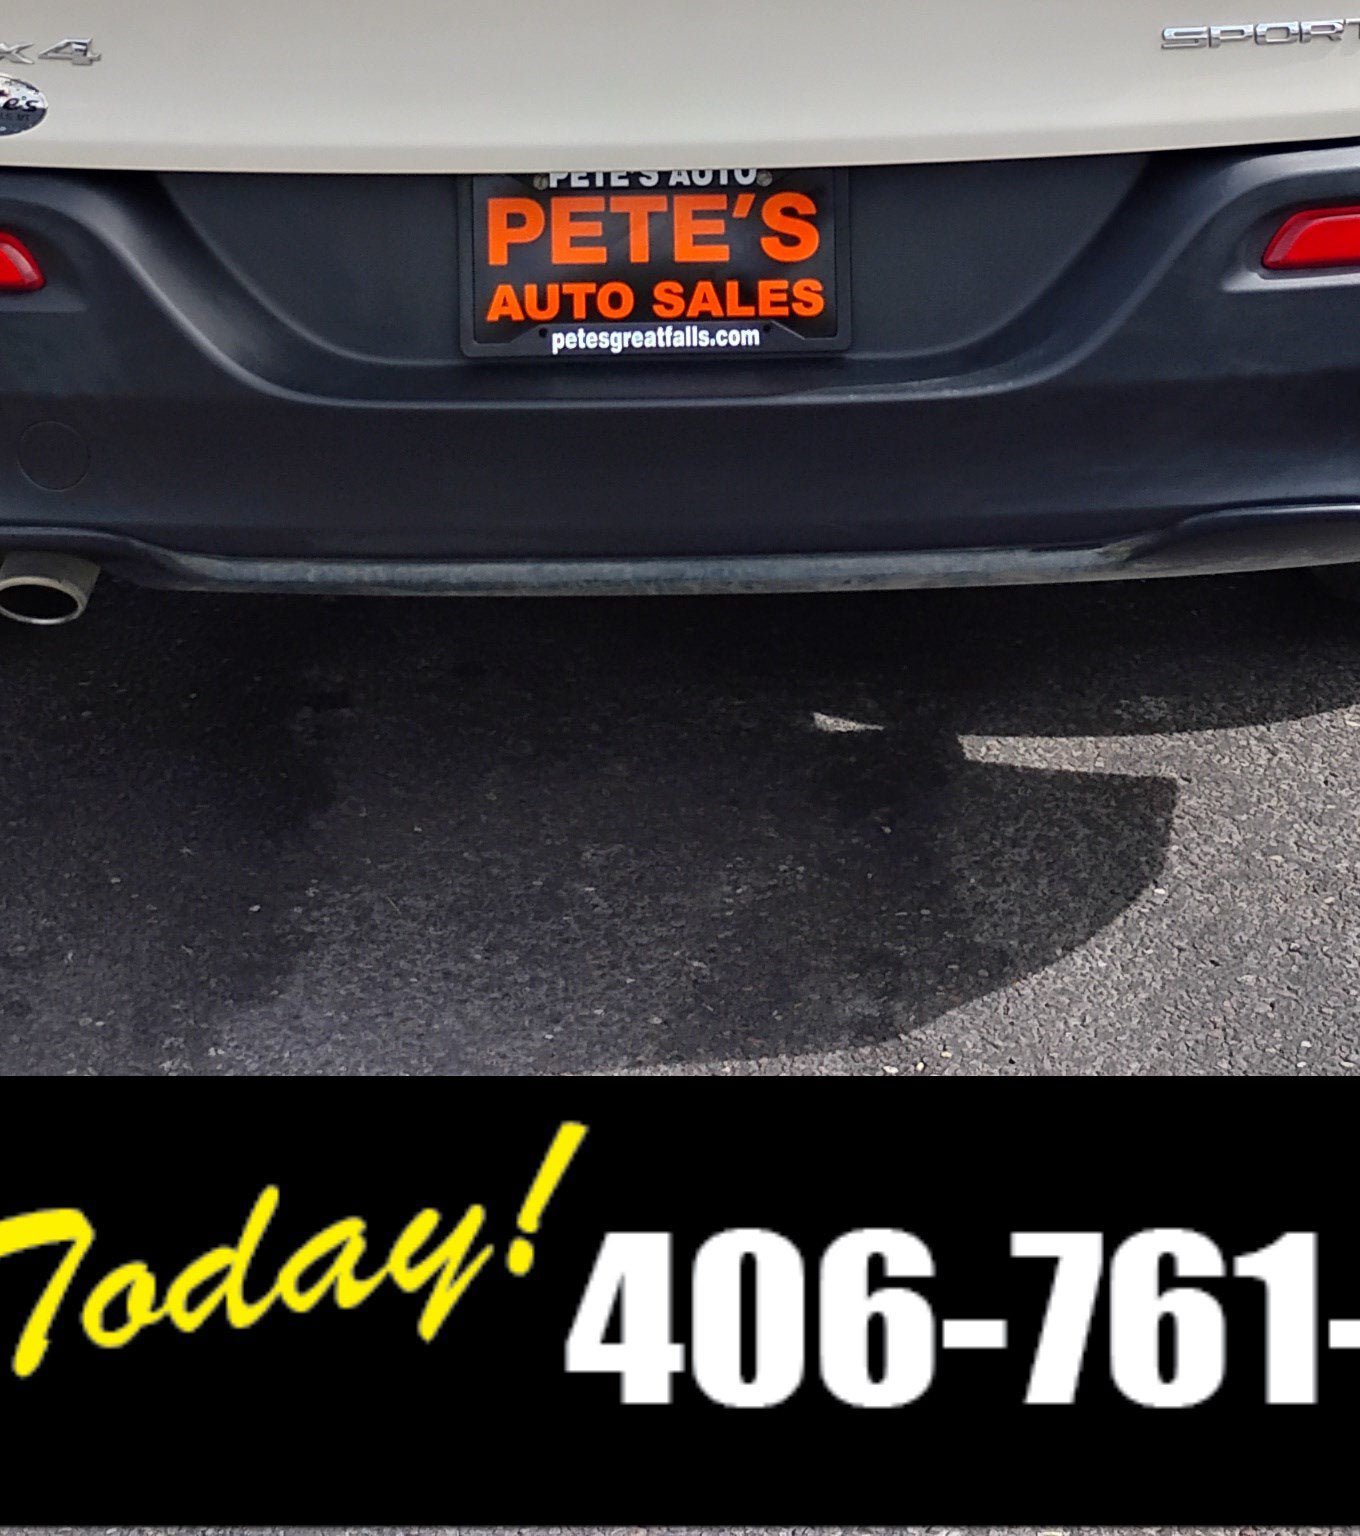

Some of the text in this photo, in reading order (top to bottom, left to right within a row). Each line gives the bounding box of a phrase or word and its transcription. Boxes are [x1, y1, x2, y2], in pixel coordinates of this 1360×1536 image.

[487, 192, 820, 266] PETE'S
[486, 278, 825, 322] AUTO SALES
[551, 325, 760, 355] petesgreatfalls.com
